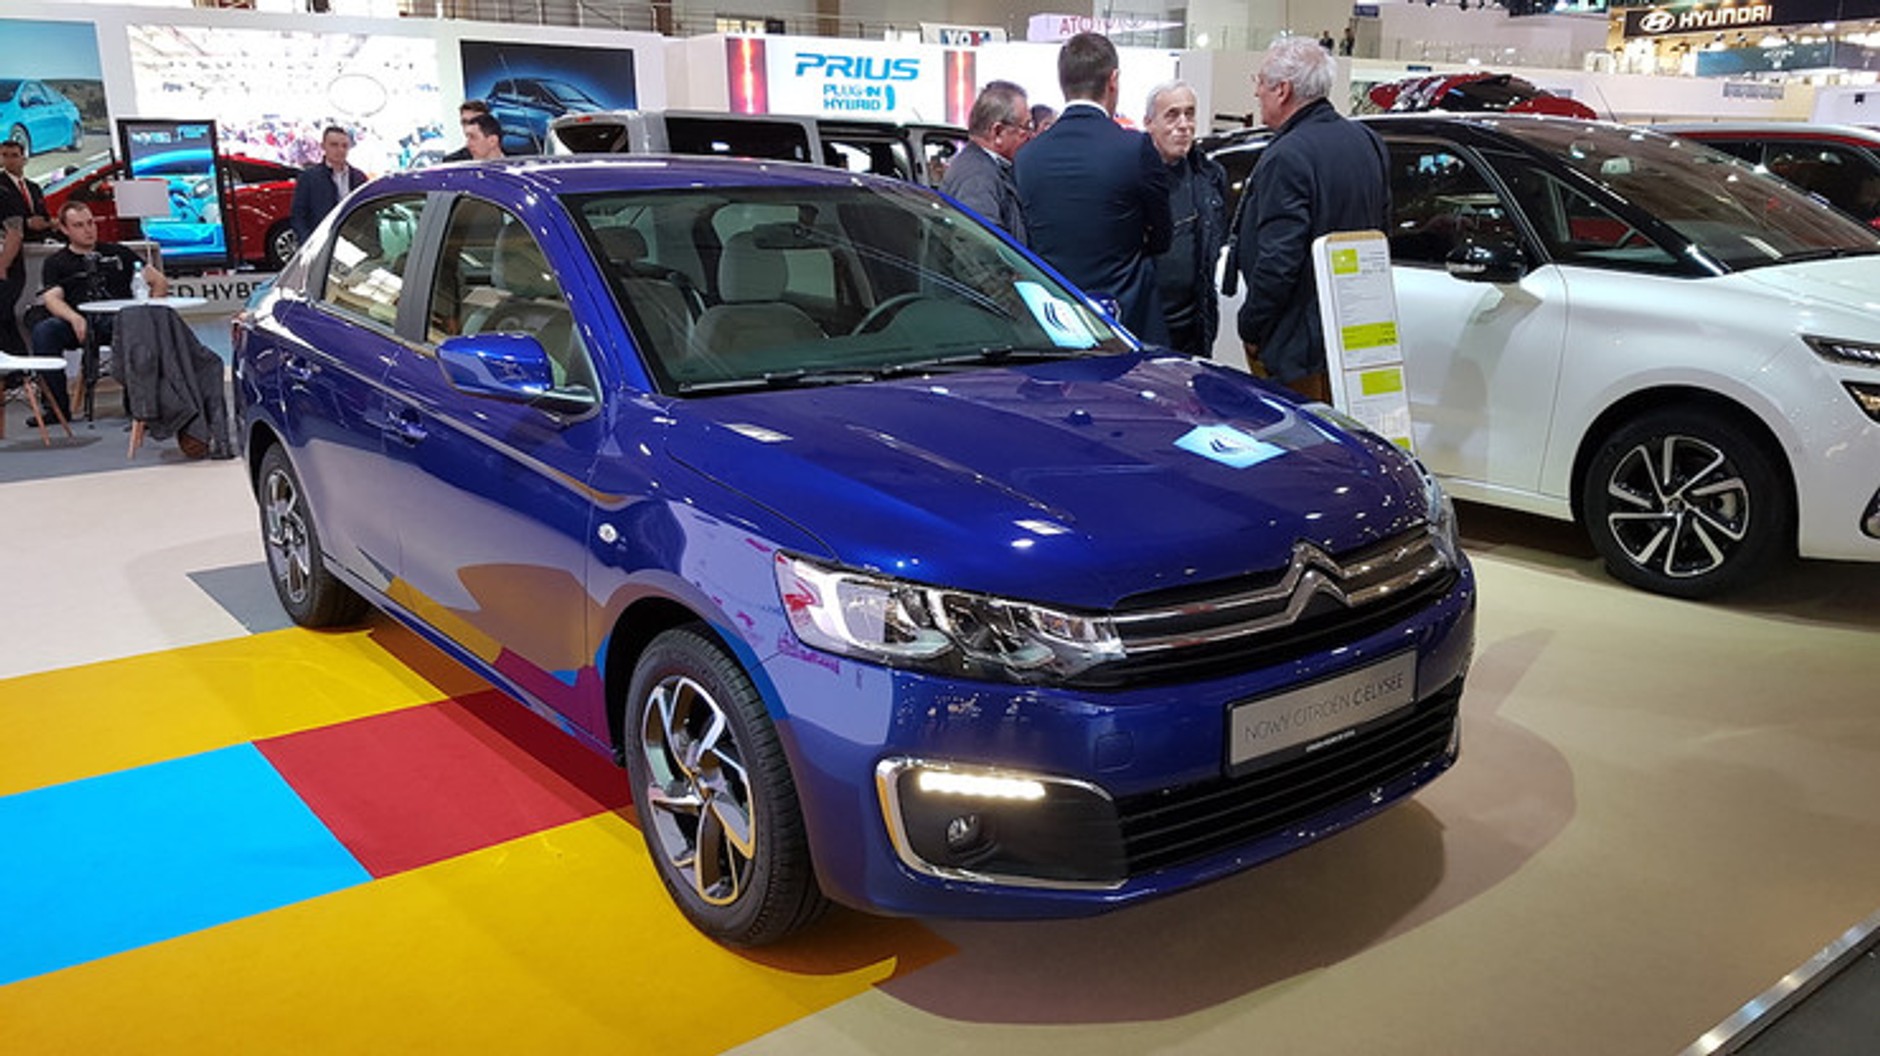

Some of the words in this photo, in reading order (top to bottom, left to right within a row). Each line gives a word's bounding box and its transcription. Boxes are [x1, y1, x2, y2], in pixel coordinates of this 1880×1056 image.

[1678, 5, 1772, 29] HYUNDAI
[795, 53, 920, 81] PRIUS
[823, 99, 882, 111] HYBRID
[1245, 716, 1288, 741] NOWY
